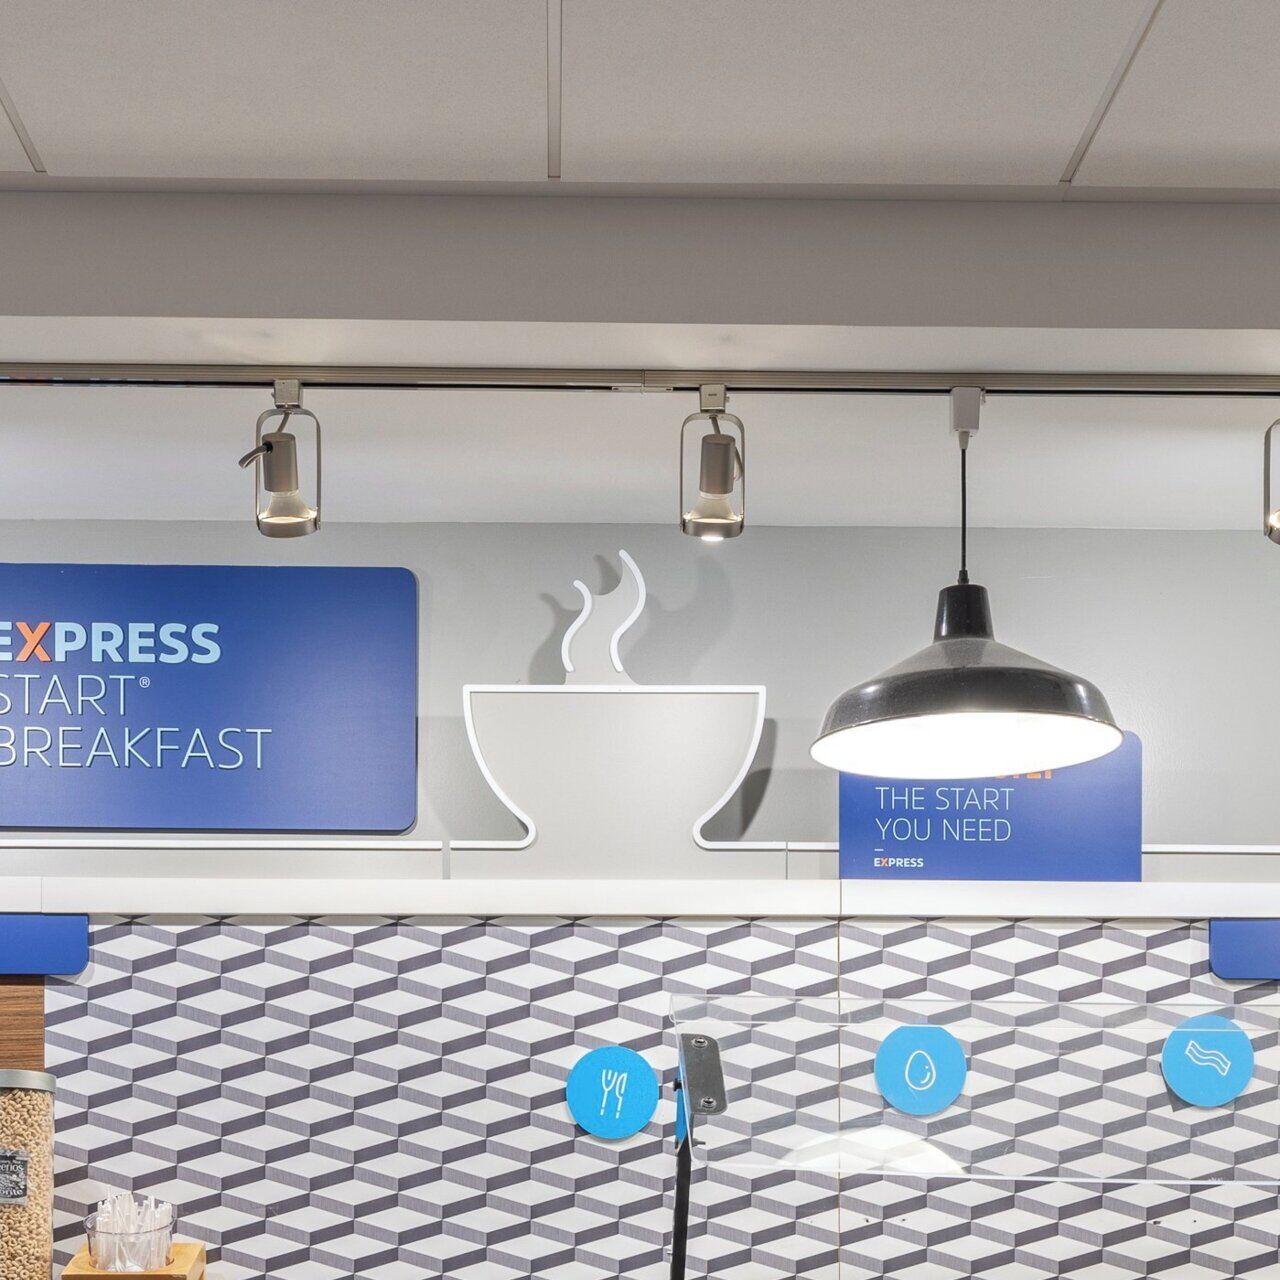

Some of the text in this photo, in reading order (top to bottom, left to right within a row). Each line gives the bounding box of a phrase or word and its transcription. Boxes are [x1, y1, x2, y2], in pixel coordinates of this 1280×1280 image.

[875, 787, 1015, 811] THE START
[875, 817, 1012, 842] YOU NEED
[874, 857, 924, 868] EXPRESS
